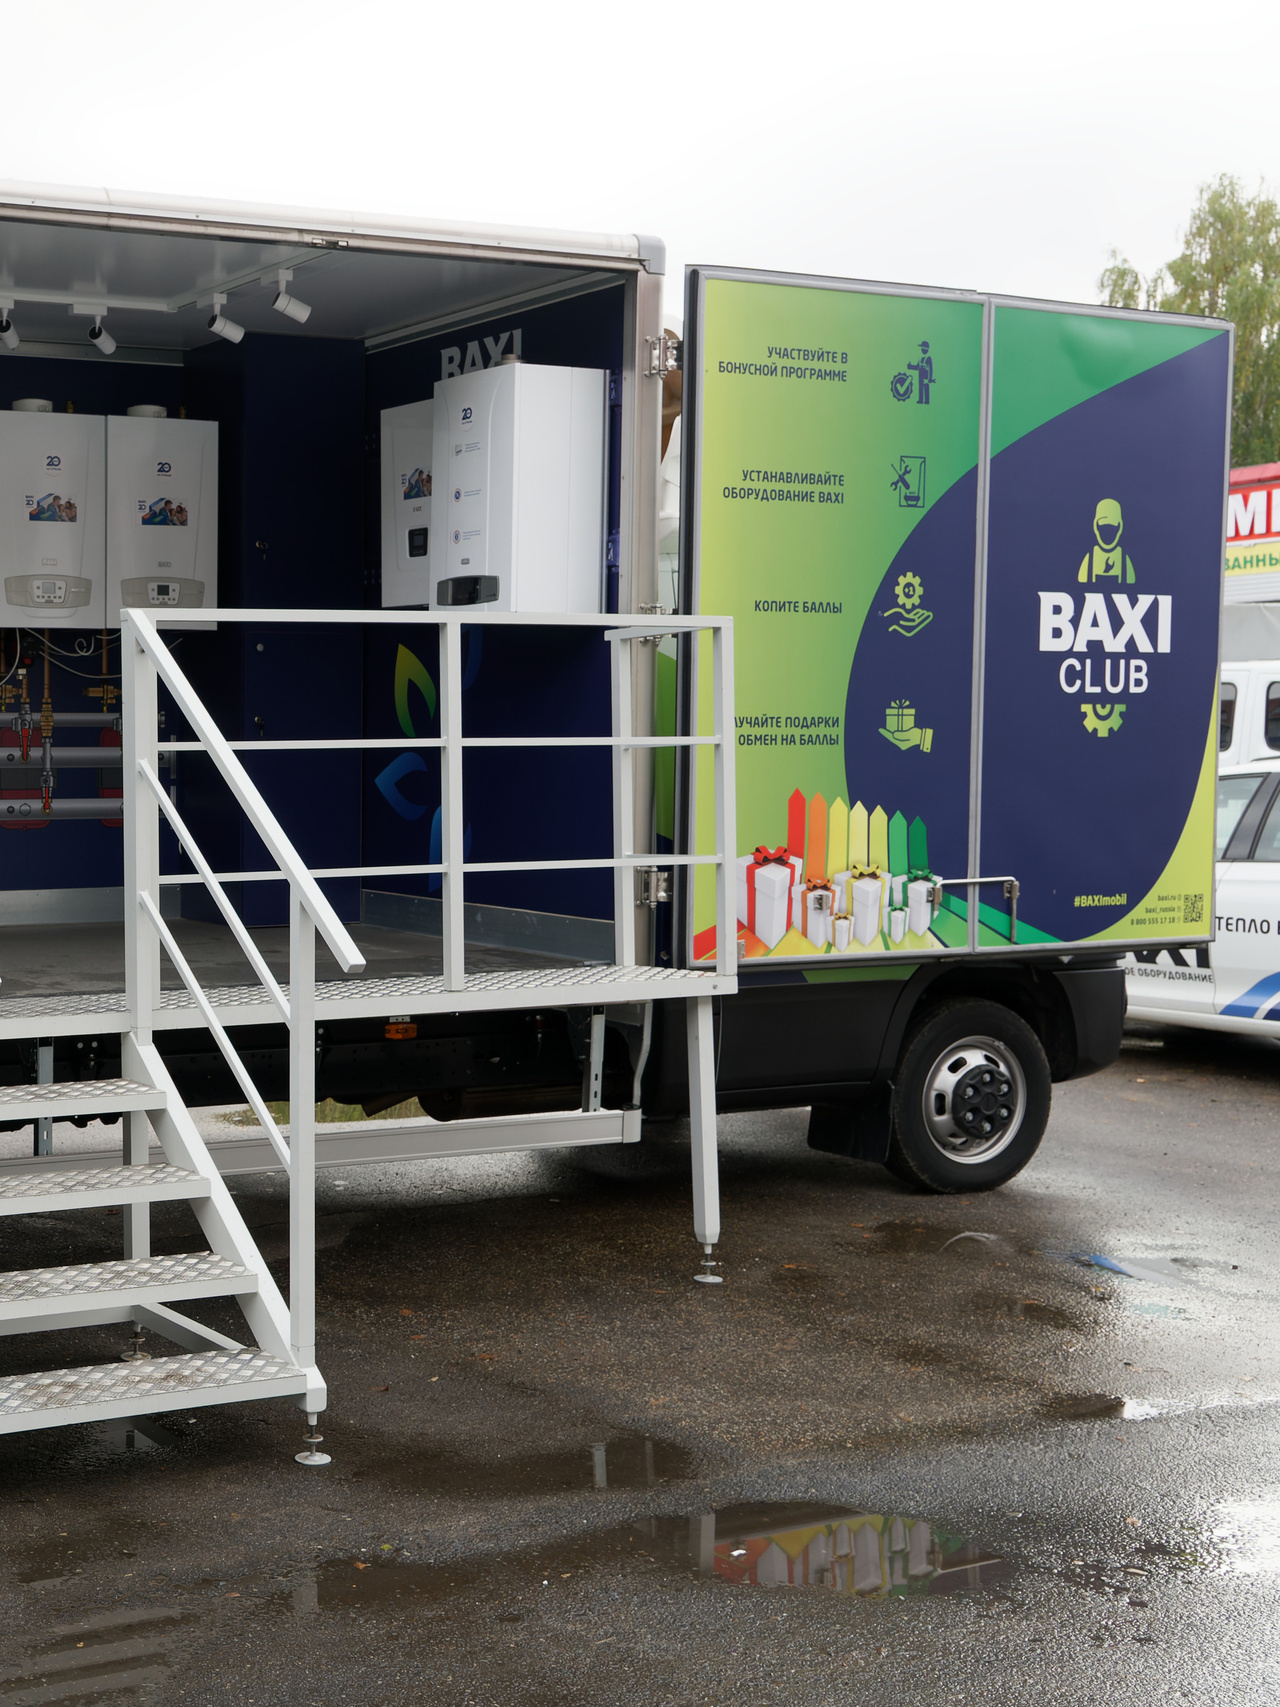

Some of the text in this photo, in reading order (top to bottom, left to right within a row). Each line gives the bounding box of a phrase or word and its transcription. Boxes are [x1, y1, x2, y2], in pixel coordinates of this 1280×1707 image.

[440, 328, 522, 380] BAXI
[767, 346, 848, 364] УЧАСТВУЙТЕ В
[718, 361, 847, 382] БОНУСНОЙ ПРОГРАММЕ
[742, 470, 844, 486] УСТАНАВЛИВАЙТЕ
[722, 487, 844, 504] ОБОРУДОВАНИЕ BAXI
[1226, 488, 1280, 537] М
[754, 600, 842, 614] КОПИТЕ БАЛЛЫ
[1037, 591, 1172, 653] BAXI
[1059, 658, 1148, 694] CLUB
[785, 717, 839, 729] ПОДАРКИ
[738, 734, 839, 746] ОБМЕН НА БАЛЛЫ
[1074, 893, 1127, 907] #BAXImobil
[1216, 916, 1270, 934] ТЕПЛО
[1138, 968, 1213, 983] ОБОРУДОВАНИЕ
